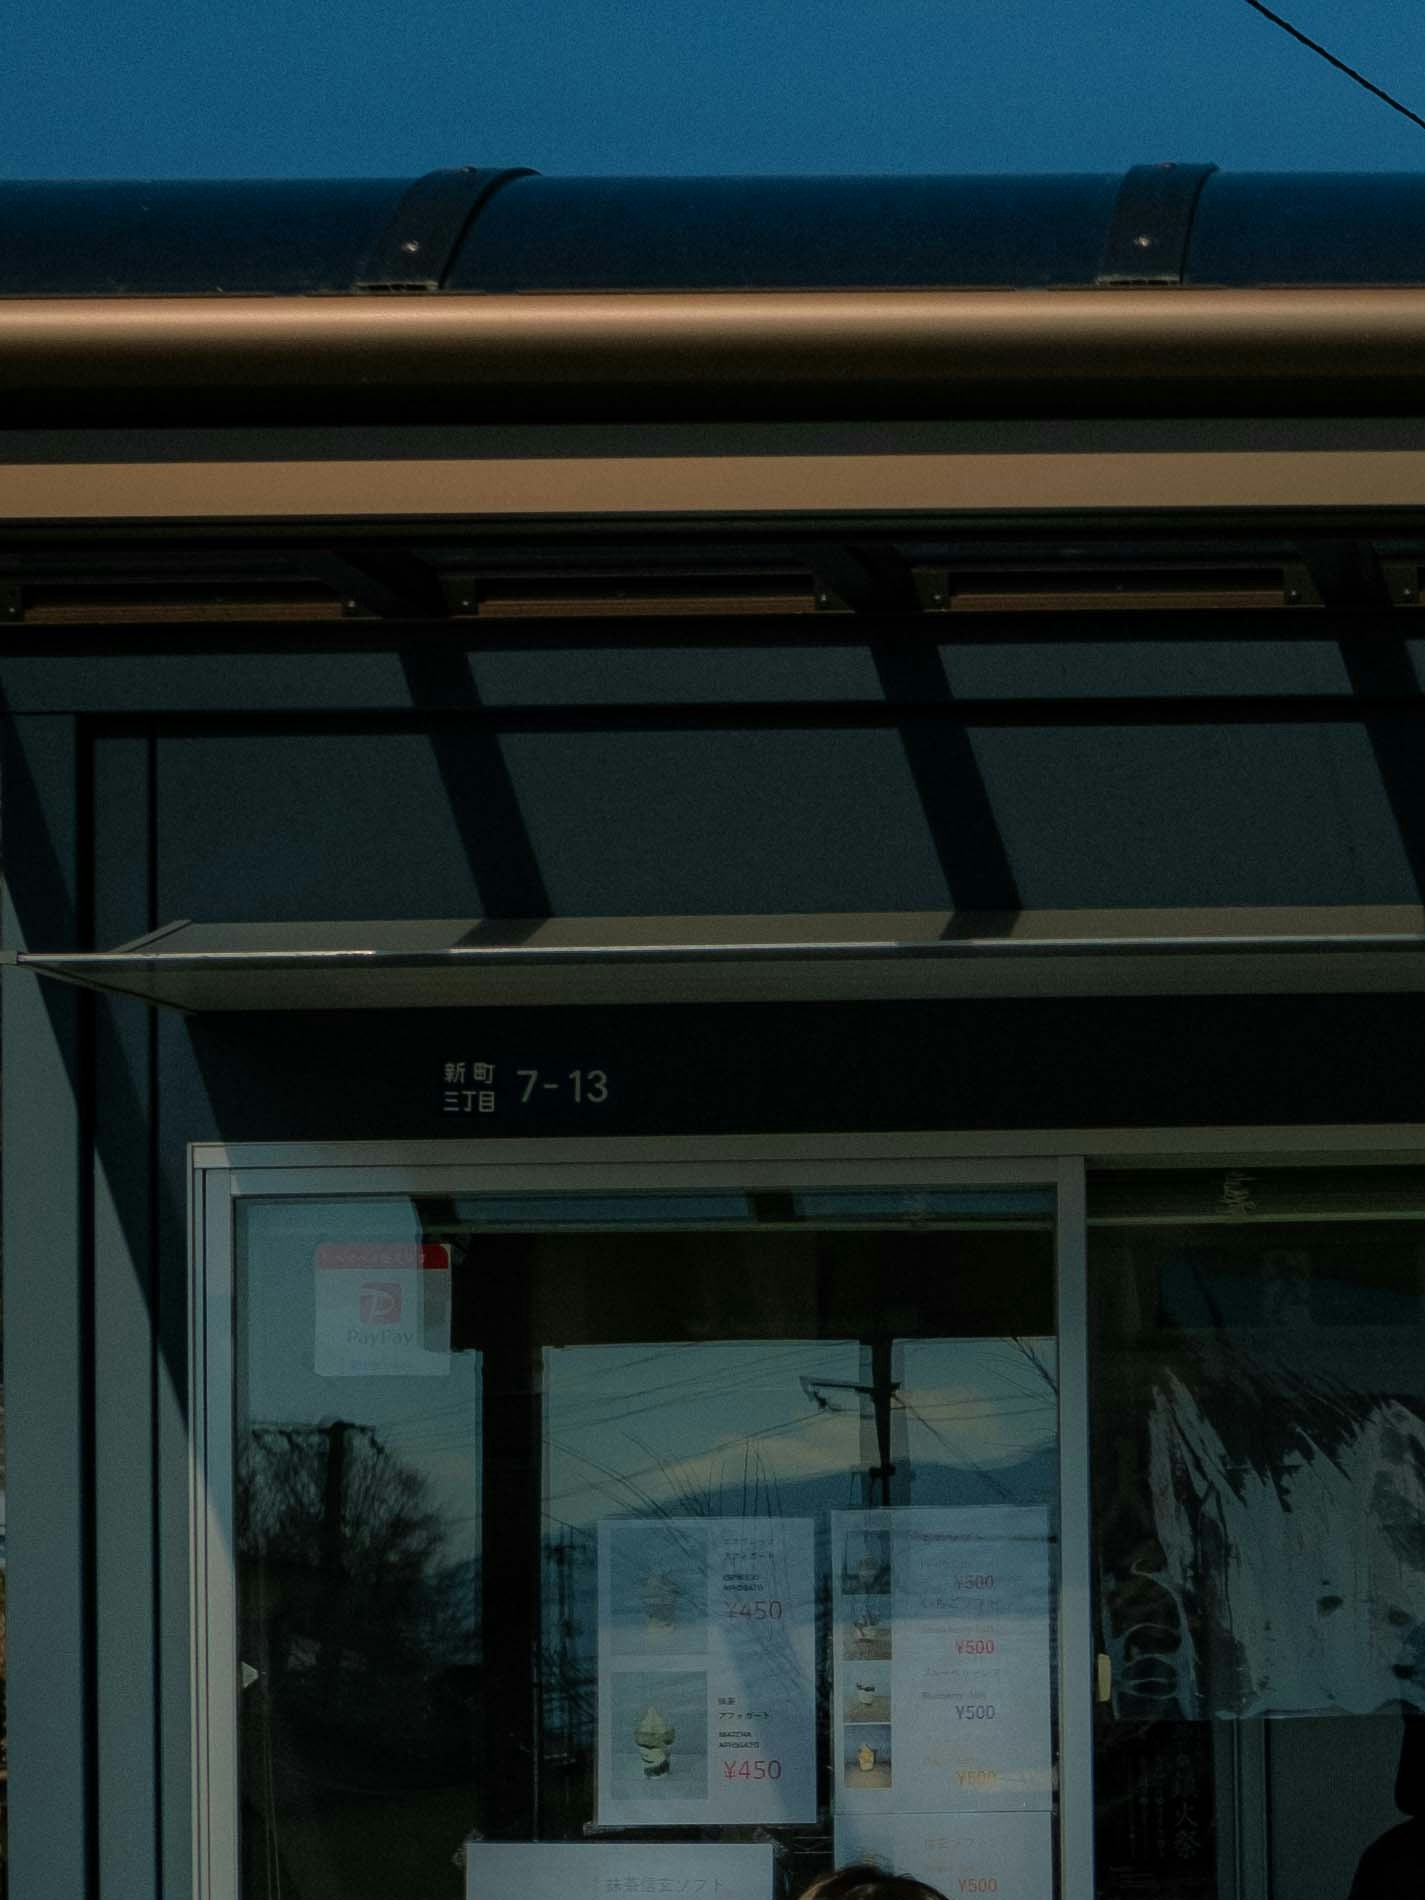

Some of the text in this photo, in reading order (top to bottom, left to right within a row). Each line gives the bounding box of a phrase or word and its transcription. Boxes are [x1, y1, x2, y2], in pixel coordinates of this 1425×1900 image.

[443, 1062, 609, 1104] 新町 7-13
[442, 1090, 496, 1113] 三丁目
[723, 1600, 783, 1621] ¥450
[955, 1640, 995, 1655] ¥500
[955, 1705, 996, 1720] ¥500
[724, 1760, 783, 1781] ¥450
[958, 1878, 999, 1893] ¥500
